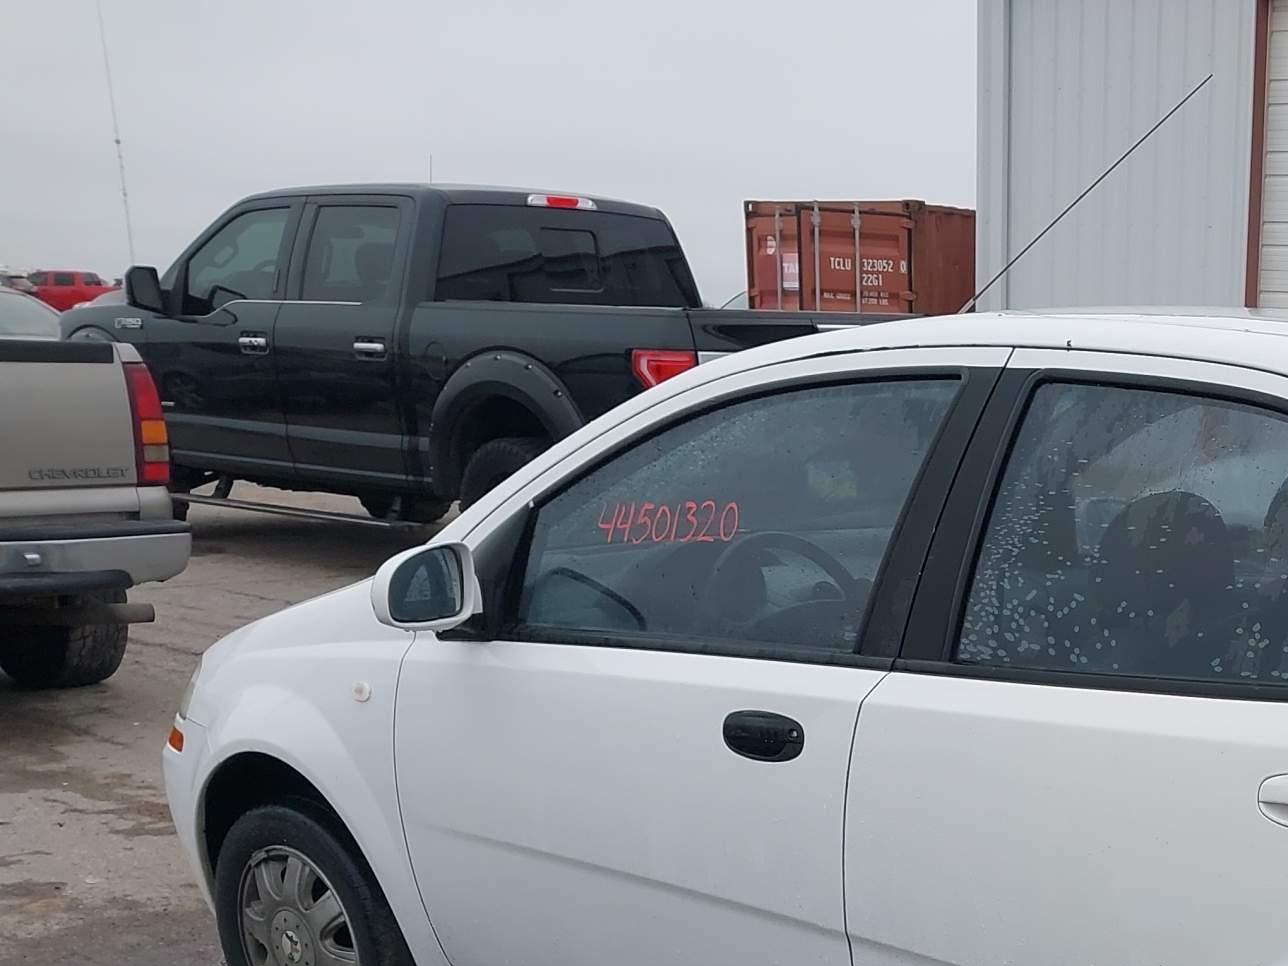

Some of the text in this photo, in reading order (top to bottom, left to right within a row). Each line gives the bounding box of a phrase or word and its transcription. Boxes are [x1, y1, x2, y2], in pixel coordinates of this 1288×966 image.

[829, 256, 852, 271] TCLU
[861, 258, 894, 272] 323052
[861, 274, 883, 286] 22G1
[28, 467, 130, 481] CHEVROLET
[598, 500, 740, 545] 44501320
